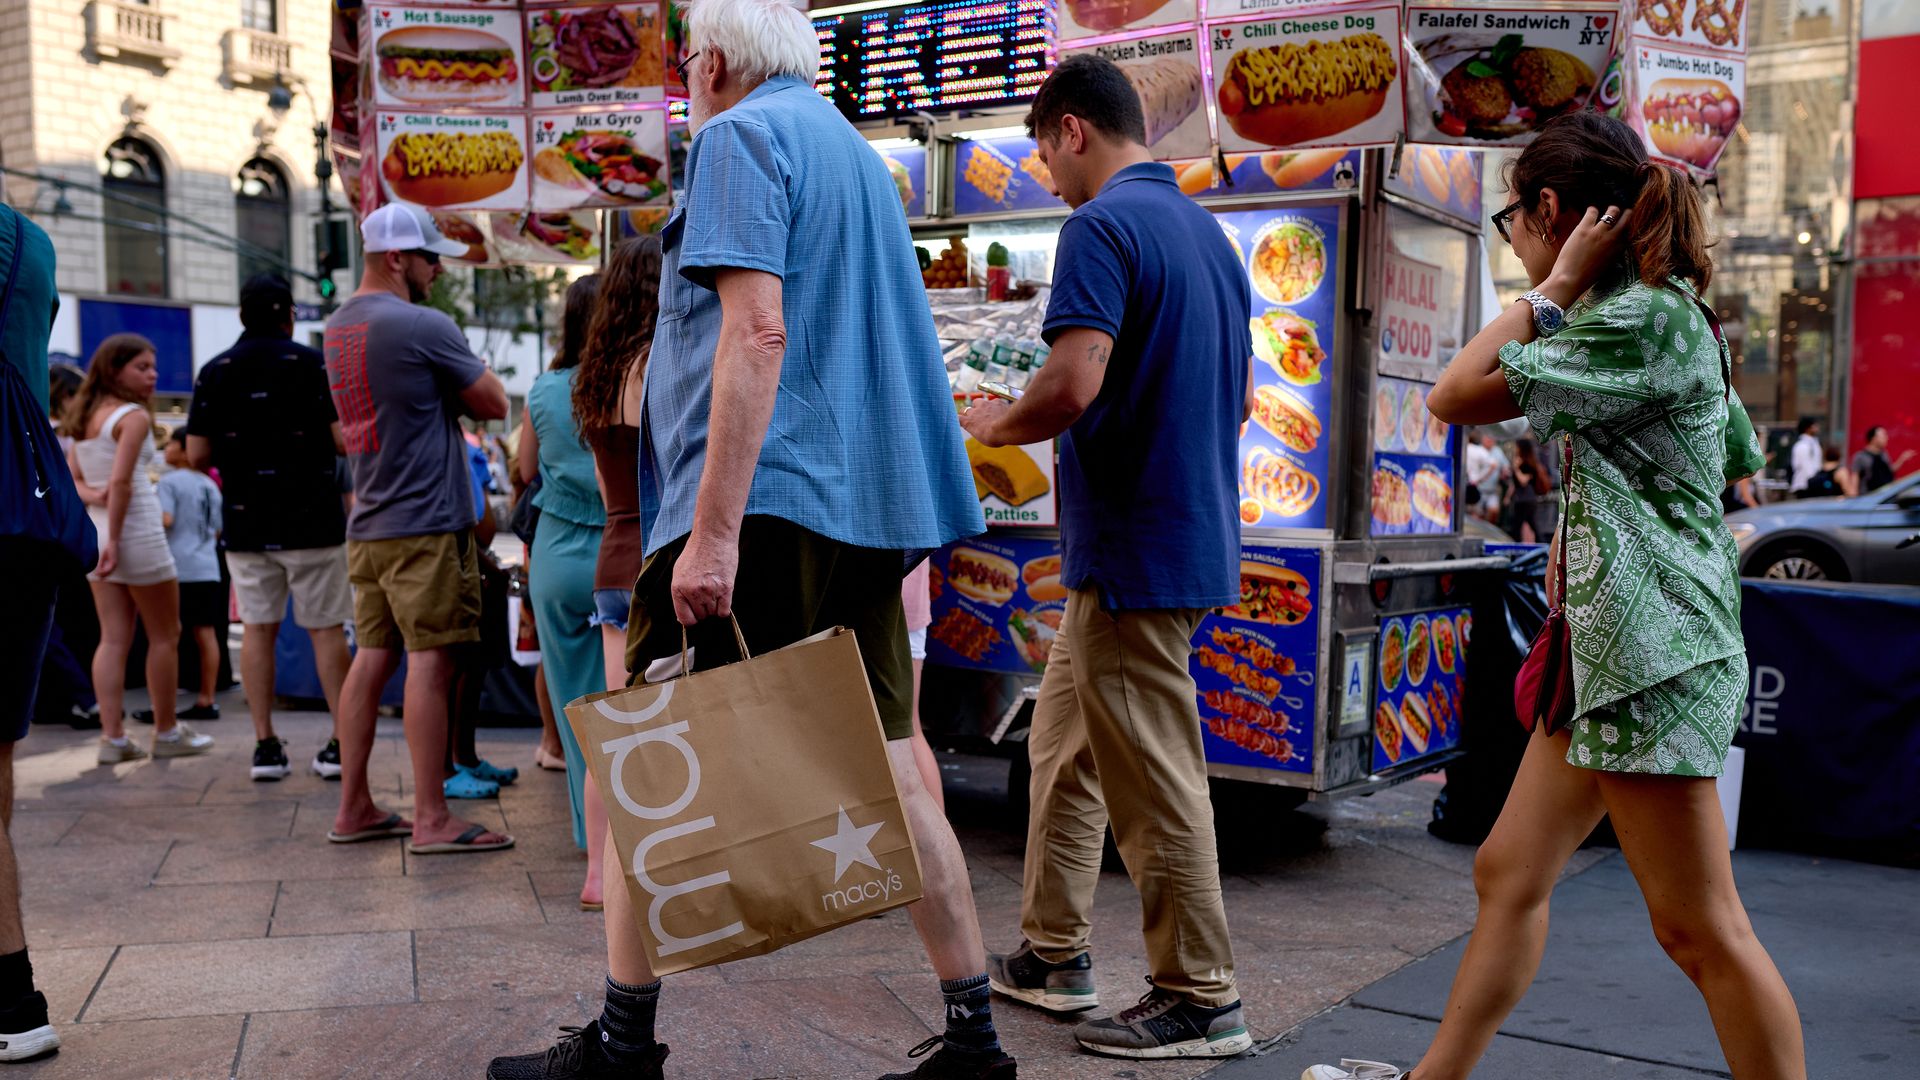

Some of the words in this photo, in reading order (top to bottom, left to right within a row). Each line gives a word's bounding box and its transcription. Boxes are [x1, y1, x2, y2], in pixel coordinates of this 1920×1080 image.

[404, 10, 429, 22] Hot
[434, 11, 494, 27] Sausage
[1243, 23, 1276, 38] Chili
[1281, 19, 1339, 34] Cheese
[1344, 15, 1375, 30] Dog
[1418, 13, 1478, 28] Falafel
[1483, 14, 1570, 30] Sandwich
[1578, 30, 1610, 45] NY
[1096, 43, 1136, 61] Chicken
[1138, 38, 1193, 57] Shawarma
[1657, 53, 1690, 71] Jumbo
[1692, 58, 1711, 74] Hot
[1714, 61, 1734, 80] Dog
[555, 93, 584, 104] Lamb
[587, 91, 612, 102] Over
[615, 91, 639, 100] Rice
[404, 115, 432, 126] Chili
[436, 116, 480, 127] Cheese
[485, 117, 509, 129] Dog
[576, 115, 601, 127] Mix
[607, 114, 643, 127] Gyro
[1384, 260, 1437, 312] HALAL
[1388, 315, 1432, 359] FOOD
[985, 507, 1039, 521] Patties
[1253, 552, 1287, 566] SAUSAGE
[1256, 632, 1276, 648] KEBAB
[1348, 660, 1361, 696] A
